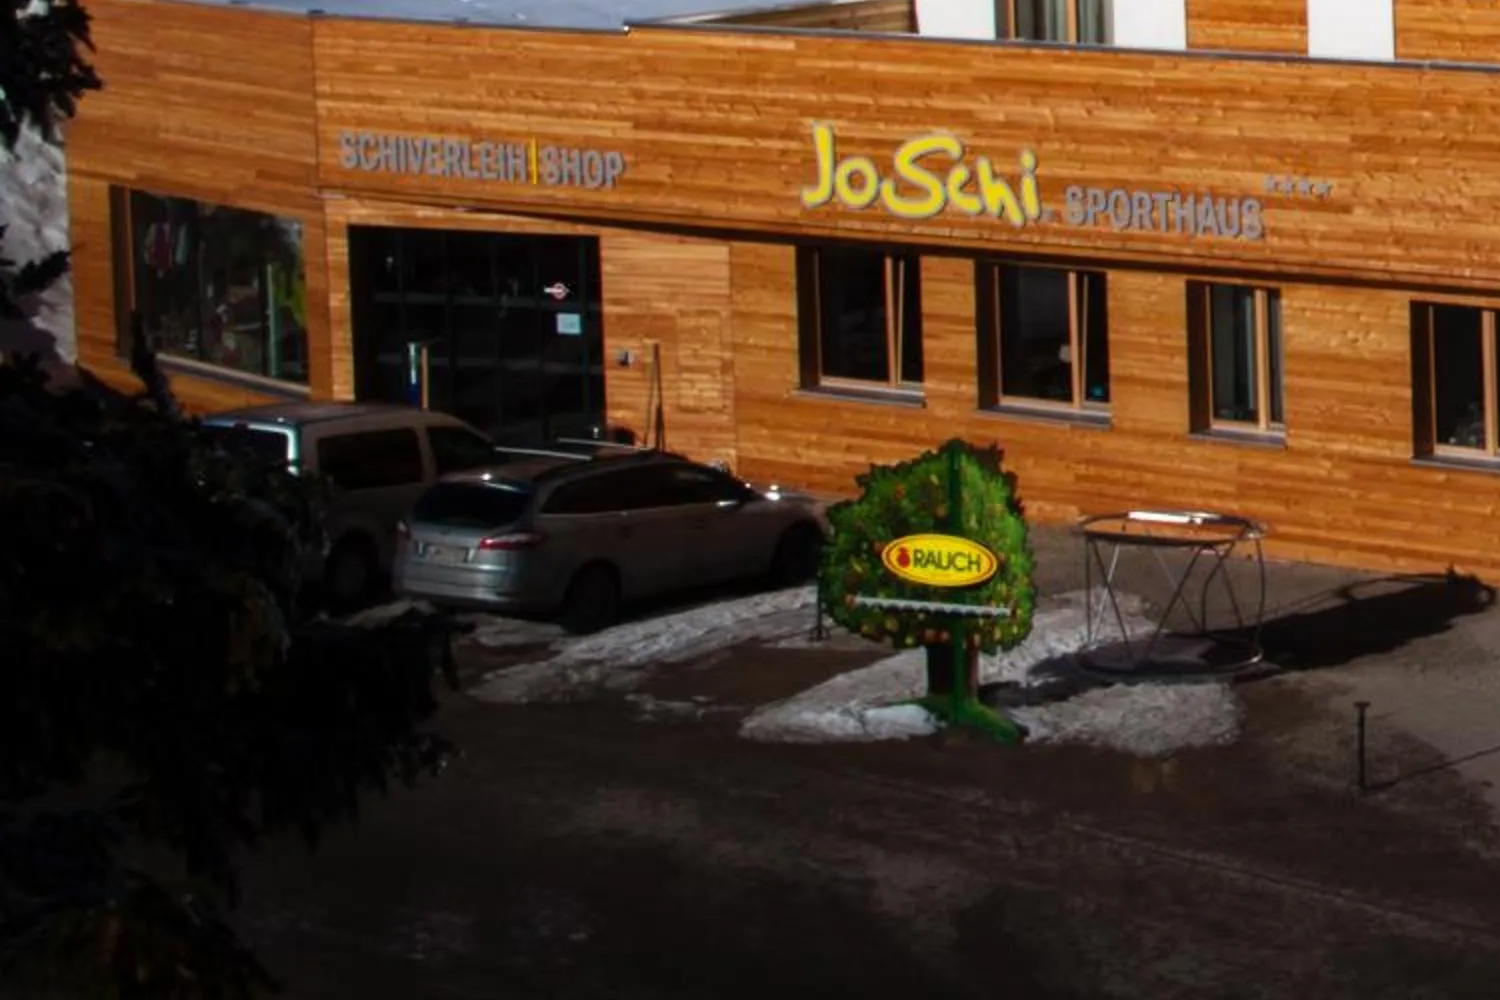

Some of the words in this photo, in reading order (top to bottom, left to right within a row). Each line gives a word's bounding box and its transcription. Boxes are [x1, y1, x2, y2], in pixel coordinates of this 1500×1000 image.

[539, 146, 625, 190] SHOP
[802, 119, 1042, 226] JoSchi
[1064, 184, 1264, 240] SPORTHAUS
[913, 548, 981, 573] RAUCH
